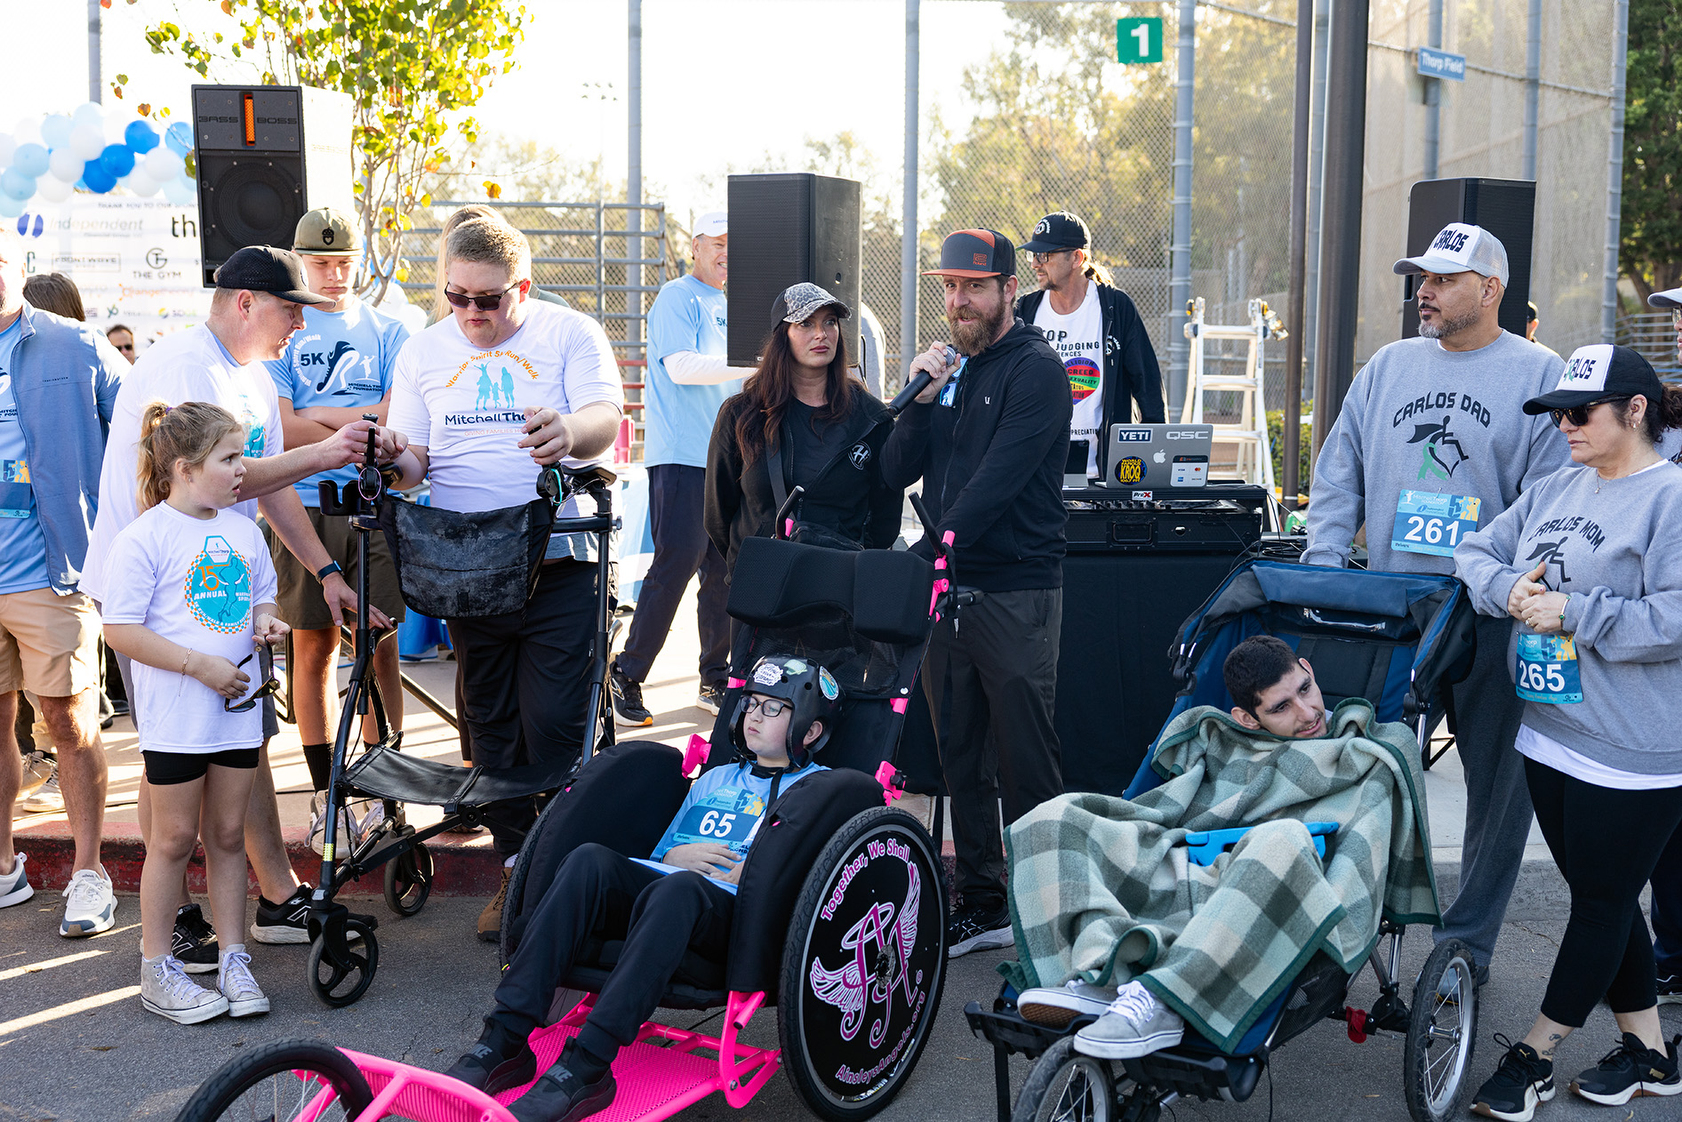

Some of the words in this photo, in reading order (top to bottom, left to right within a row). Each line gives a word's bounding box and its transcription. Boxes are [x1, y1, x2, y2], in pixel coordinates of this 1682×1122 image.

[1131, 23, 1149, 57] 1
[1422, 52, 1443, 72] Thorp
[1444, 57, 1463, 74] Field
[257, 117, 297, 125] BOSS
[50, 216, 144, 232] Independent
[133, 271, 153, 280] THE
[158, 271, 182, 280] GYM
[1056, 341, 1100, 351] JUDGING
[300, 352, 326, 366] 5K
[504, 349, 540, 380] Run/Walk
[1067, 368, 1094, 376] CREED
[1392, 391, 1458, 429] CARLOS
[1460, 393, 1491, 428] DAD
[1121, 431, 1150, 441] YETI
[1166, 431, 1209, 441] QSC
[1120, 464, 1141, 480] KROQ
[1404, 516, 1460, 546] 261
[1579, 520, 1606, 554] MOM
[198, 565, 220, 592] 15
[194, 590, 228, 601] ANNUAL
[1519, 660, 1565, 693] 265
[699, 810, 737, 838] 65
[821, 853, 869, 922] Together,
[867, 839, 886, 861] We
[886, 838, 911, 864] Shall
[835, 990, 926, 1085] AinsleysAngels.org
